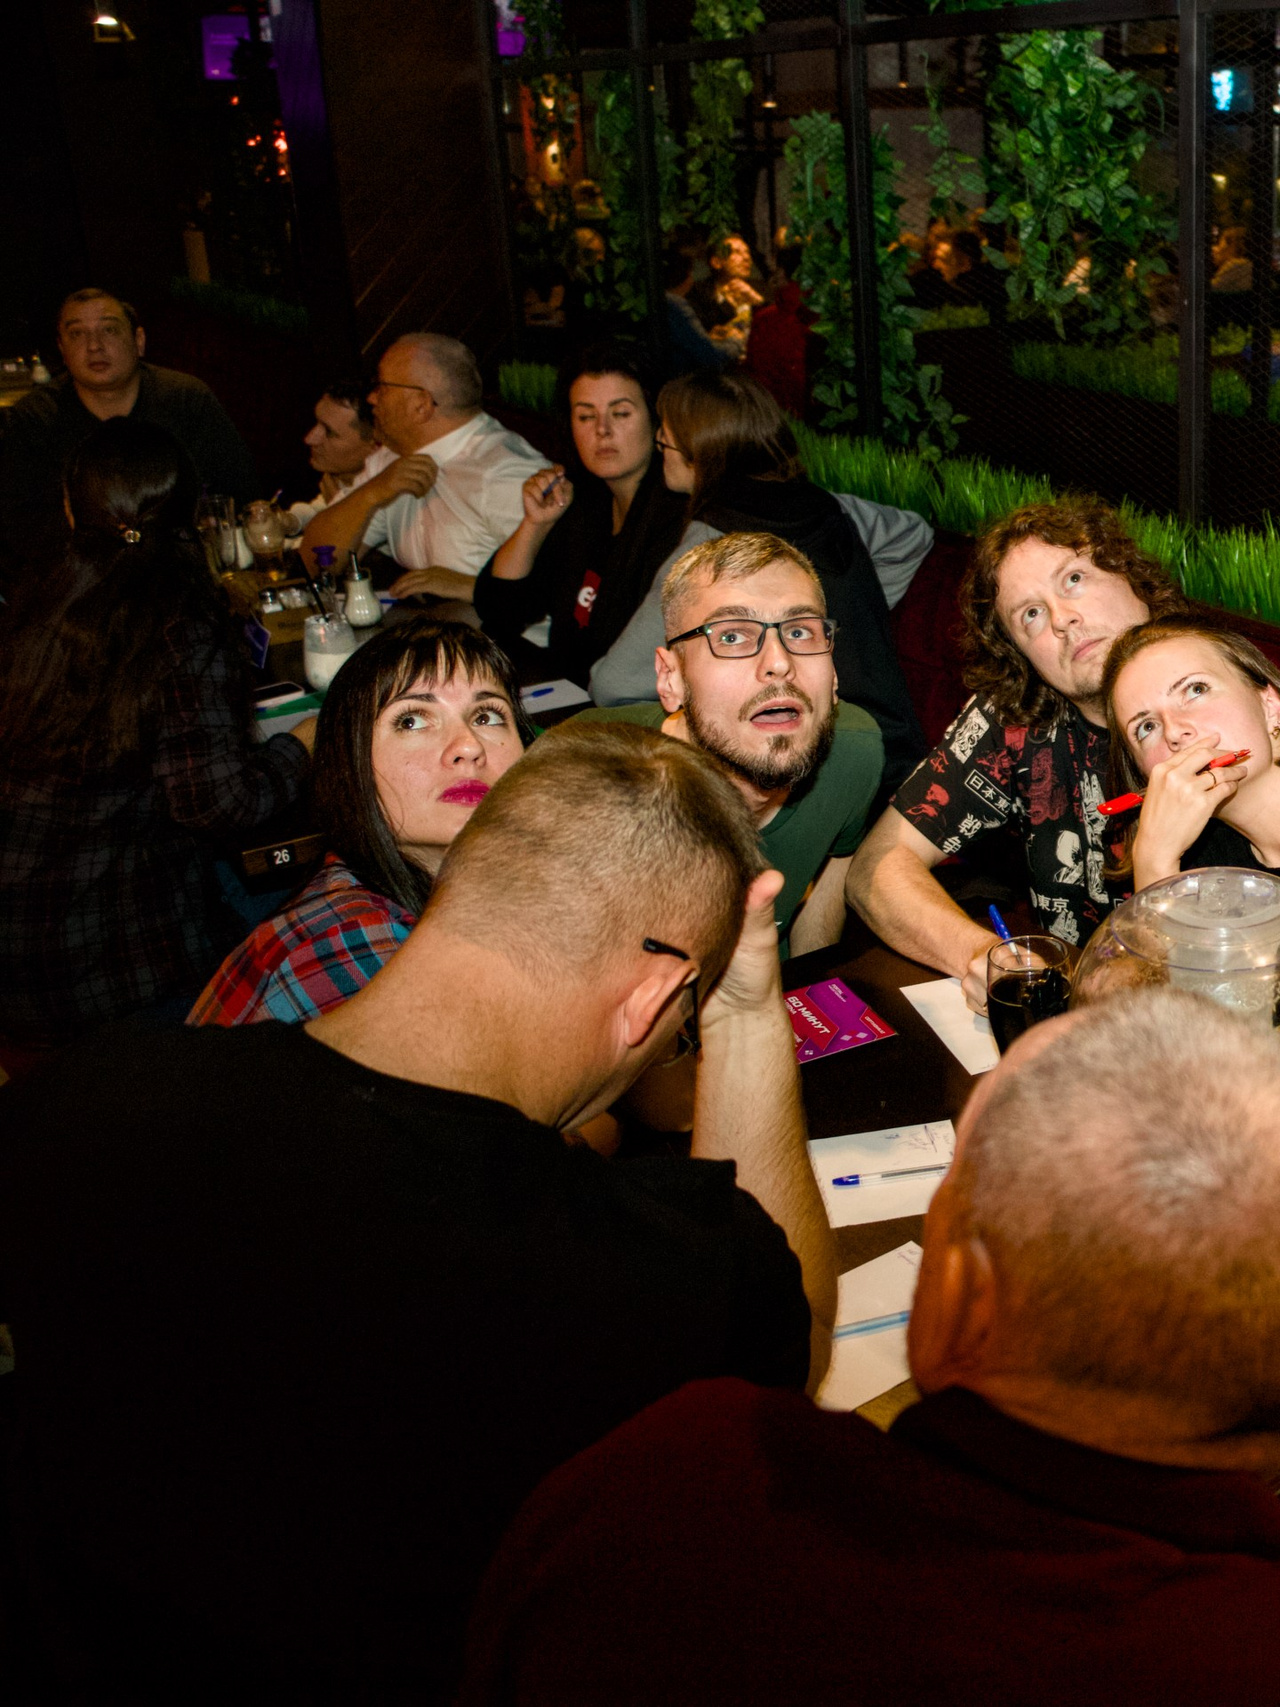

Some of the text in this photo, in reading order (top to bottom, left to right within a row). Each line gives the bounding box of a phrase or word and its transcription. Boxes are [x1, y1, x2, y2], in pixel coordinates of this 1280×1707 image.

[273, 849, 290, 865] 26
[787, 996, 804, 1008] 60
[798, 1007, 831, 1034] МИНУТ
